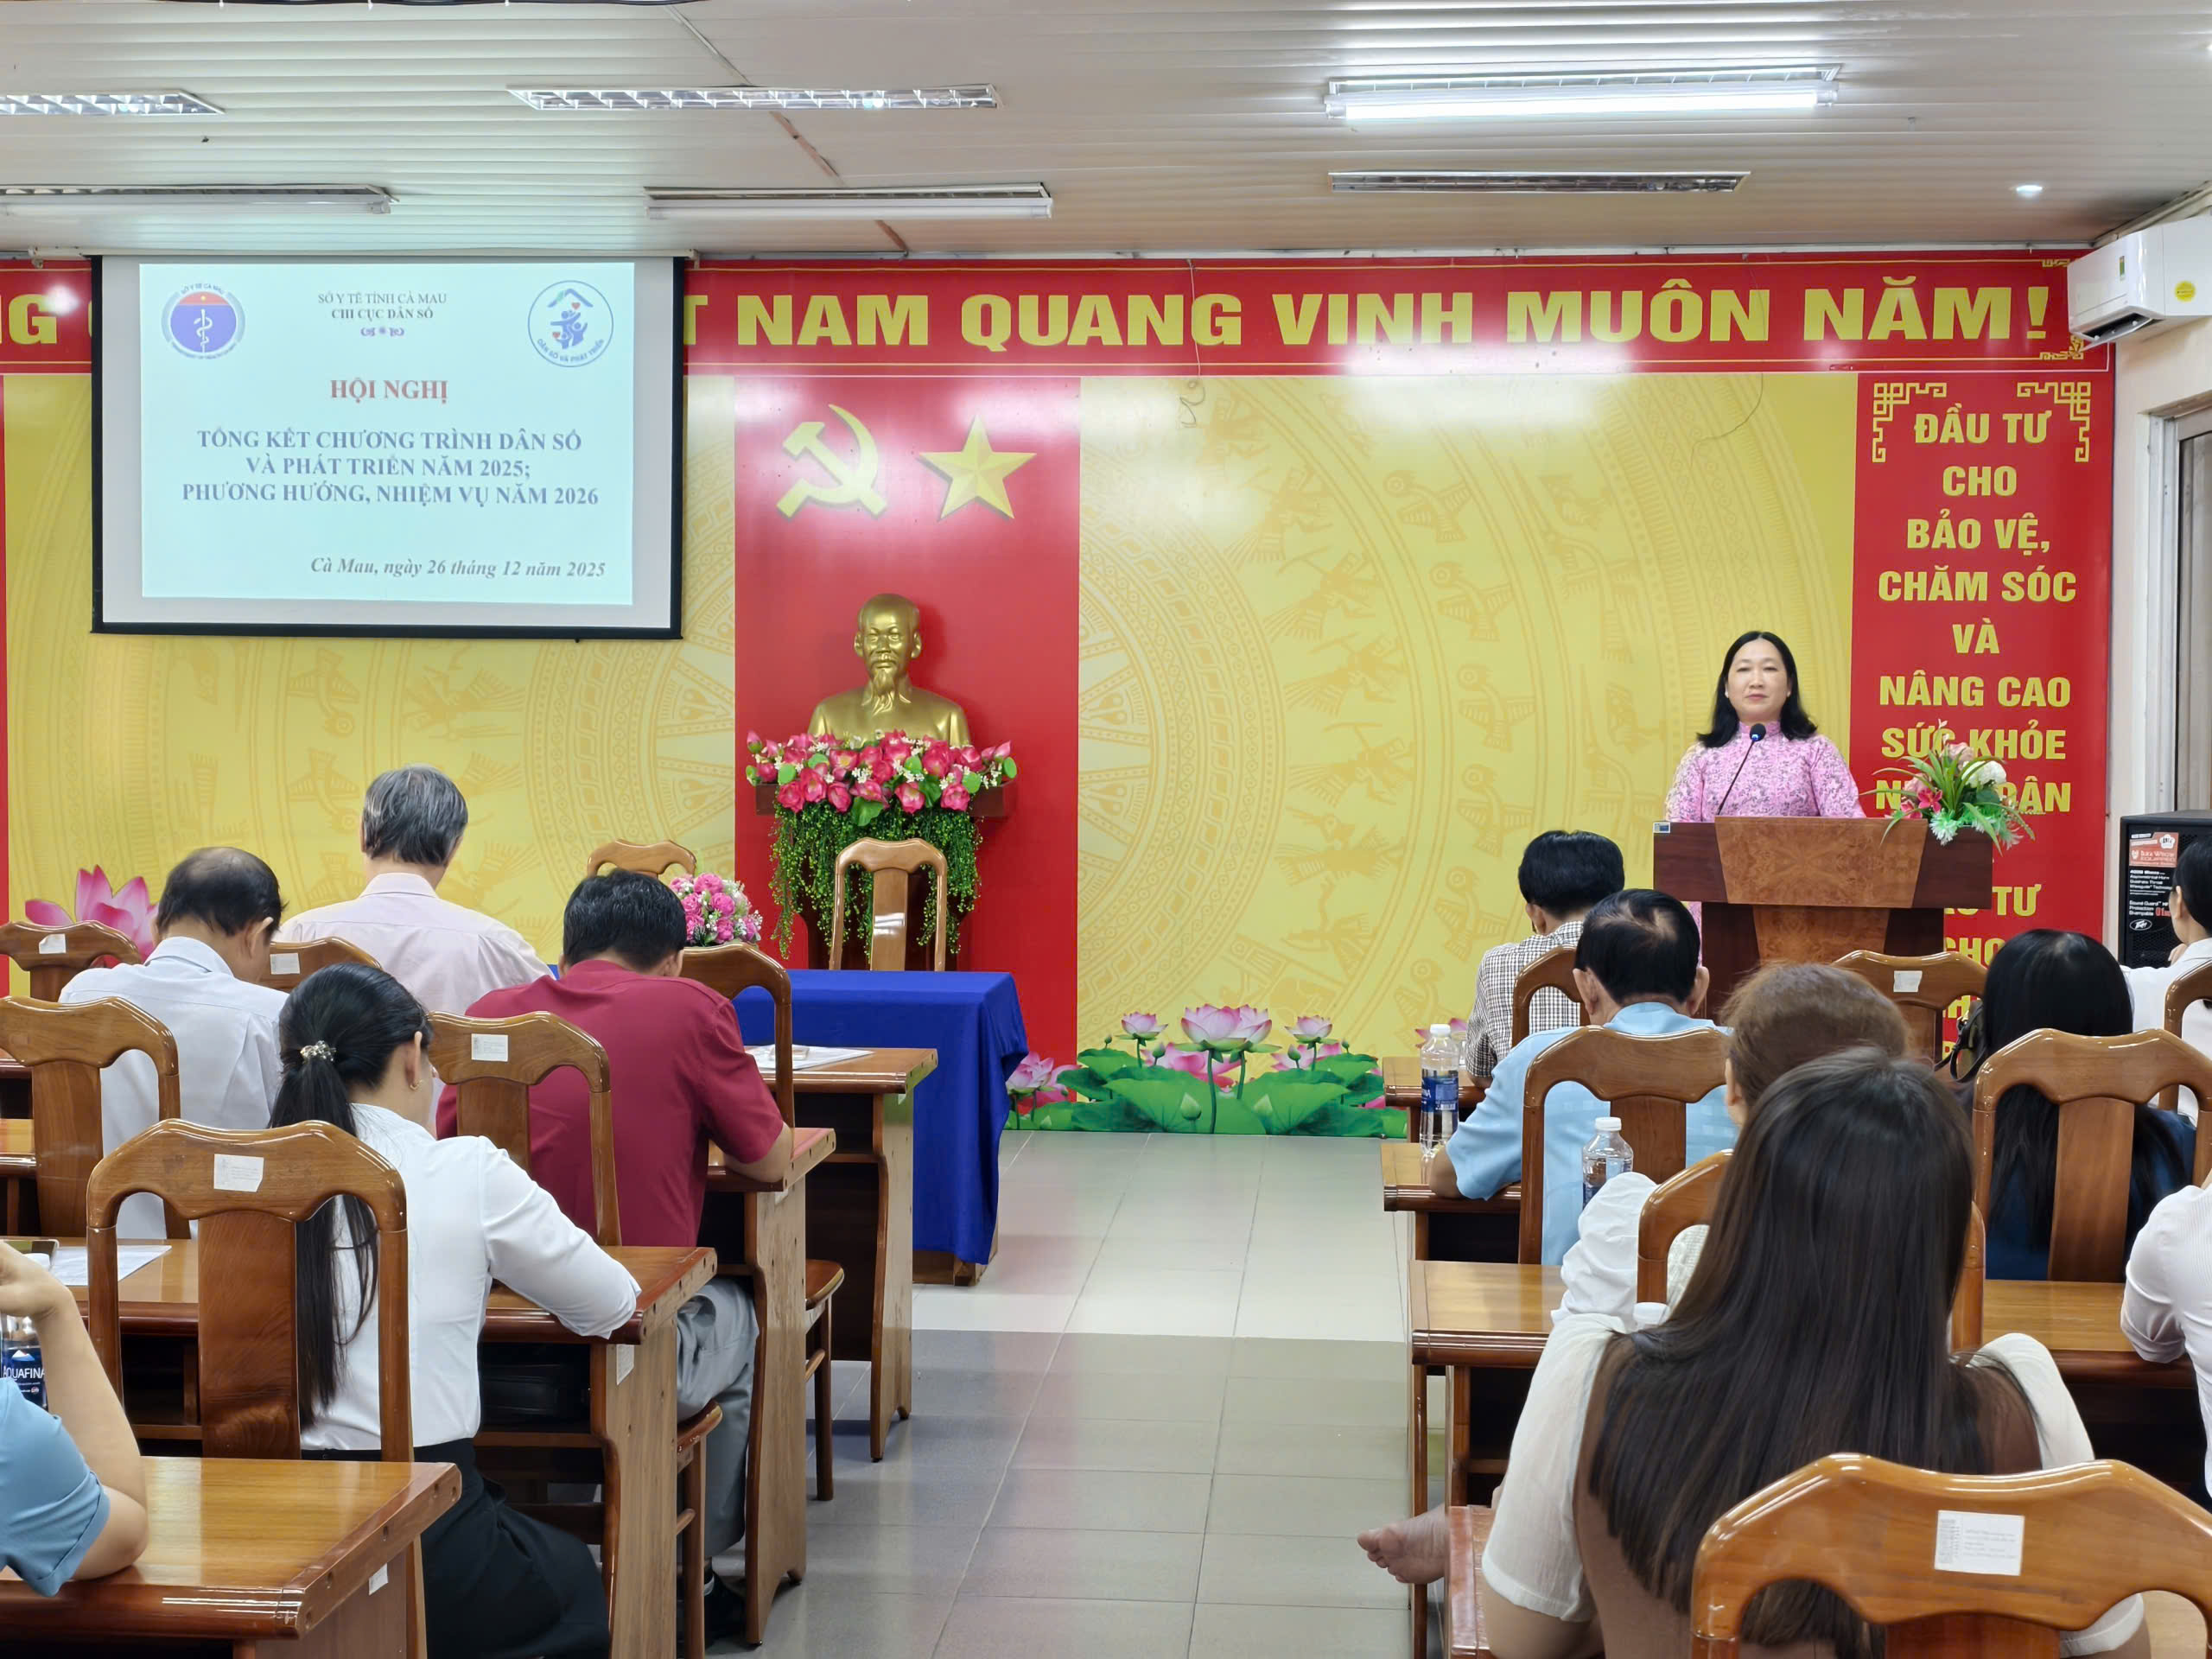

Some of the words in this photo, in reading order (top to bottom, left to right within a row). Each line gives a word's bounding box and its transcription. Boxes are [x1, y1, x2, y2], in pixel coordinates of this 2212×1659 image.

[336, 293, 344, 303] Y
[418, 293, 447, 303] MAU
[0, 295, 57, 345] G
[358, 308, 385, 321] CỤC
[737, 295, 928, 346] NAM
[962, 293, 1242, 352] QUANG
[1272, 292, 1473, 346] VINH
[1506, 278, 1770, 342] MUÔN
[330, 377, 376, 404] HỘI
[384, 379, 448, 404] NGHỊ
[197, 426, 259, 448] TỔNG
[266, 427, 310, 448] KẾT
[316, 429, 415, 449] CHƯƠNG
[421, 428, 491, 449] TRÌNH
[499, 428, 545, 450] DÂN
[552, 429, 582, 450] SỐ
[1914, 403, 1989, 443] ĐẦU
[2002, 410, 2052, 443] TƯ
[246, 453, 276, 474] VÀ
[283, 454, 341, 474] PHÁT
[346, 454, 415, 475] TRIỂN
[422, 455, 473, 476] NĂM
[480, 460, 531, 479] 2025;
[1942, 466, 2017, 496] CHO
[182, 481, 276, 501] PHƯƠNG
[283, 480, 371, 504] HƯỚNG,
[378, 483, 451, 506] NHIỆM
[459, 486, 489, 507] VỤ
[496, 484, 547, 505] NĂM
[555, 486, 599, 505] 2026
[1907, 508, 1981, 549] BẢO
[1994, 512, 2050, 556] VỆ,
[310, 557, 333, 573] Cà
[337, 558, 378, 575] Mau,
[384, 559, 422, 578] ngày
[427, 559, 446, 575] 26
[450, 559, 497, 579] tháng
[503, 561, 520, 575] 12
[525, 563, 561, 576] năm
[566, 562, 606, 577] 2025
[1878, 565, 1987, 601] CHĂM
[2001, 565, 2076, 602] SÓC
[1952, 617, 1999, 653] VÀ
[1879, 670, 1984, 706] NÂNG
[1998, 677, 2071, 707] CAO
[1969, 719, 2066, 760] KHỎE
[1992, 884, 2042, 917] TƯ
[3, 1365, 45, 1382] AQUAFINA
